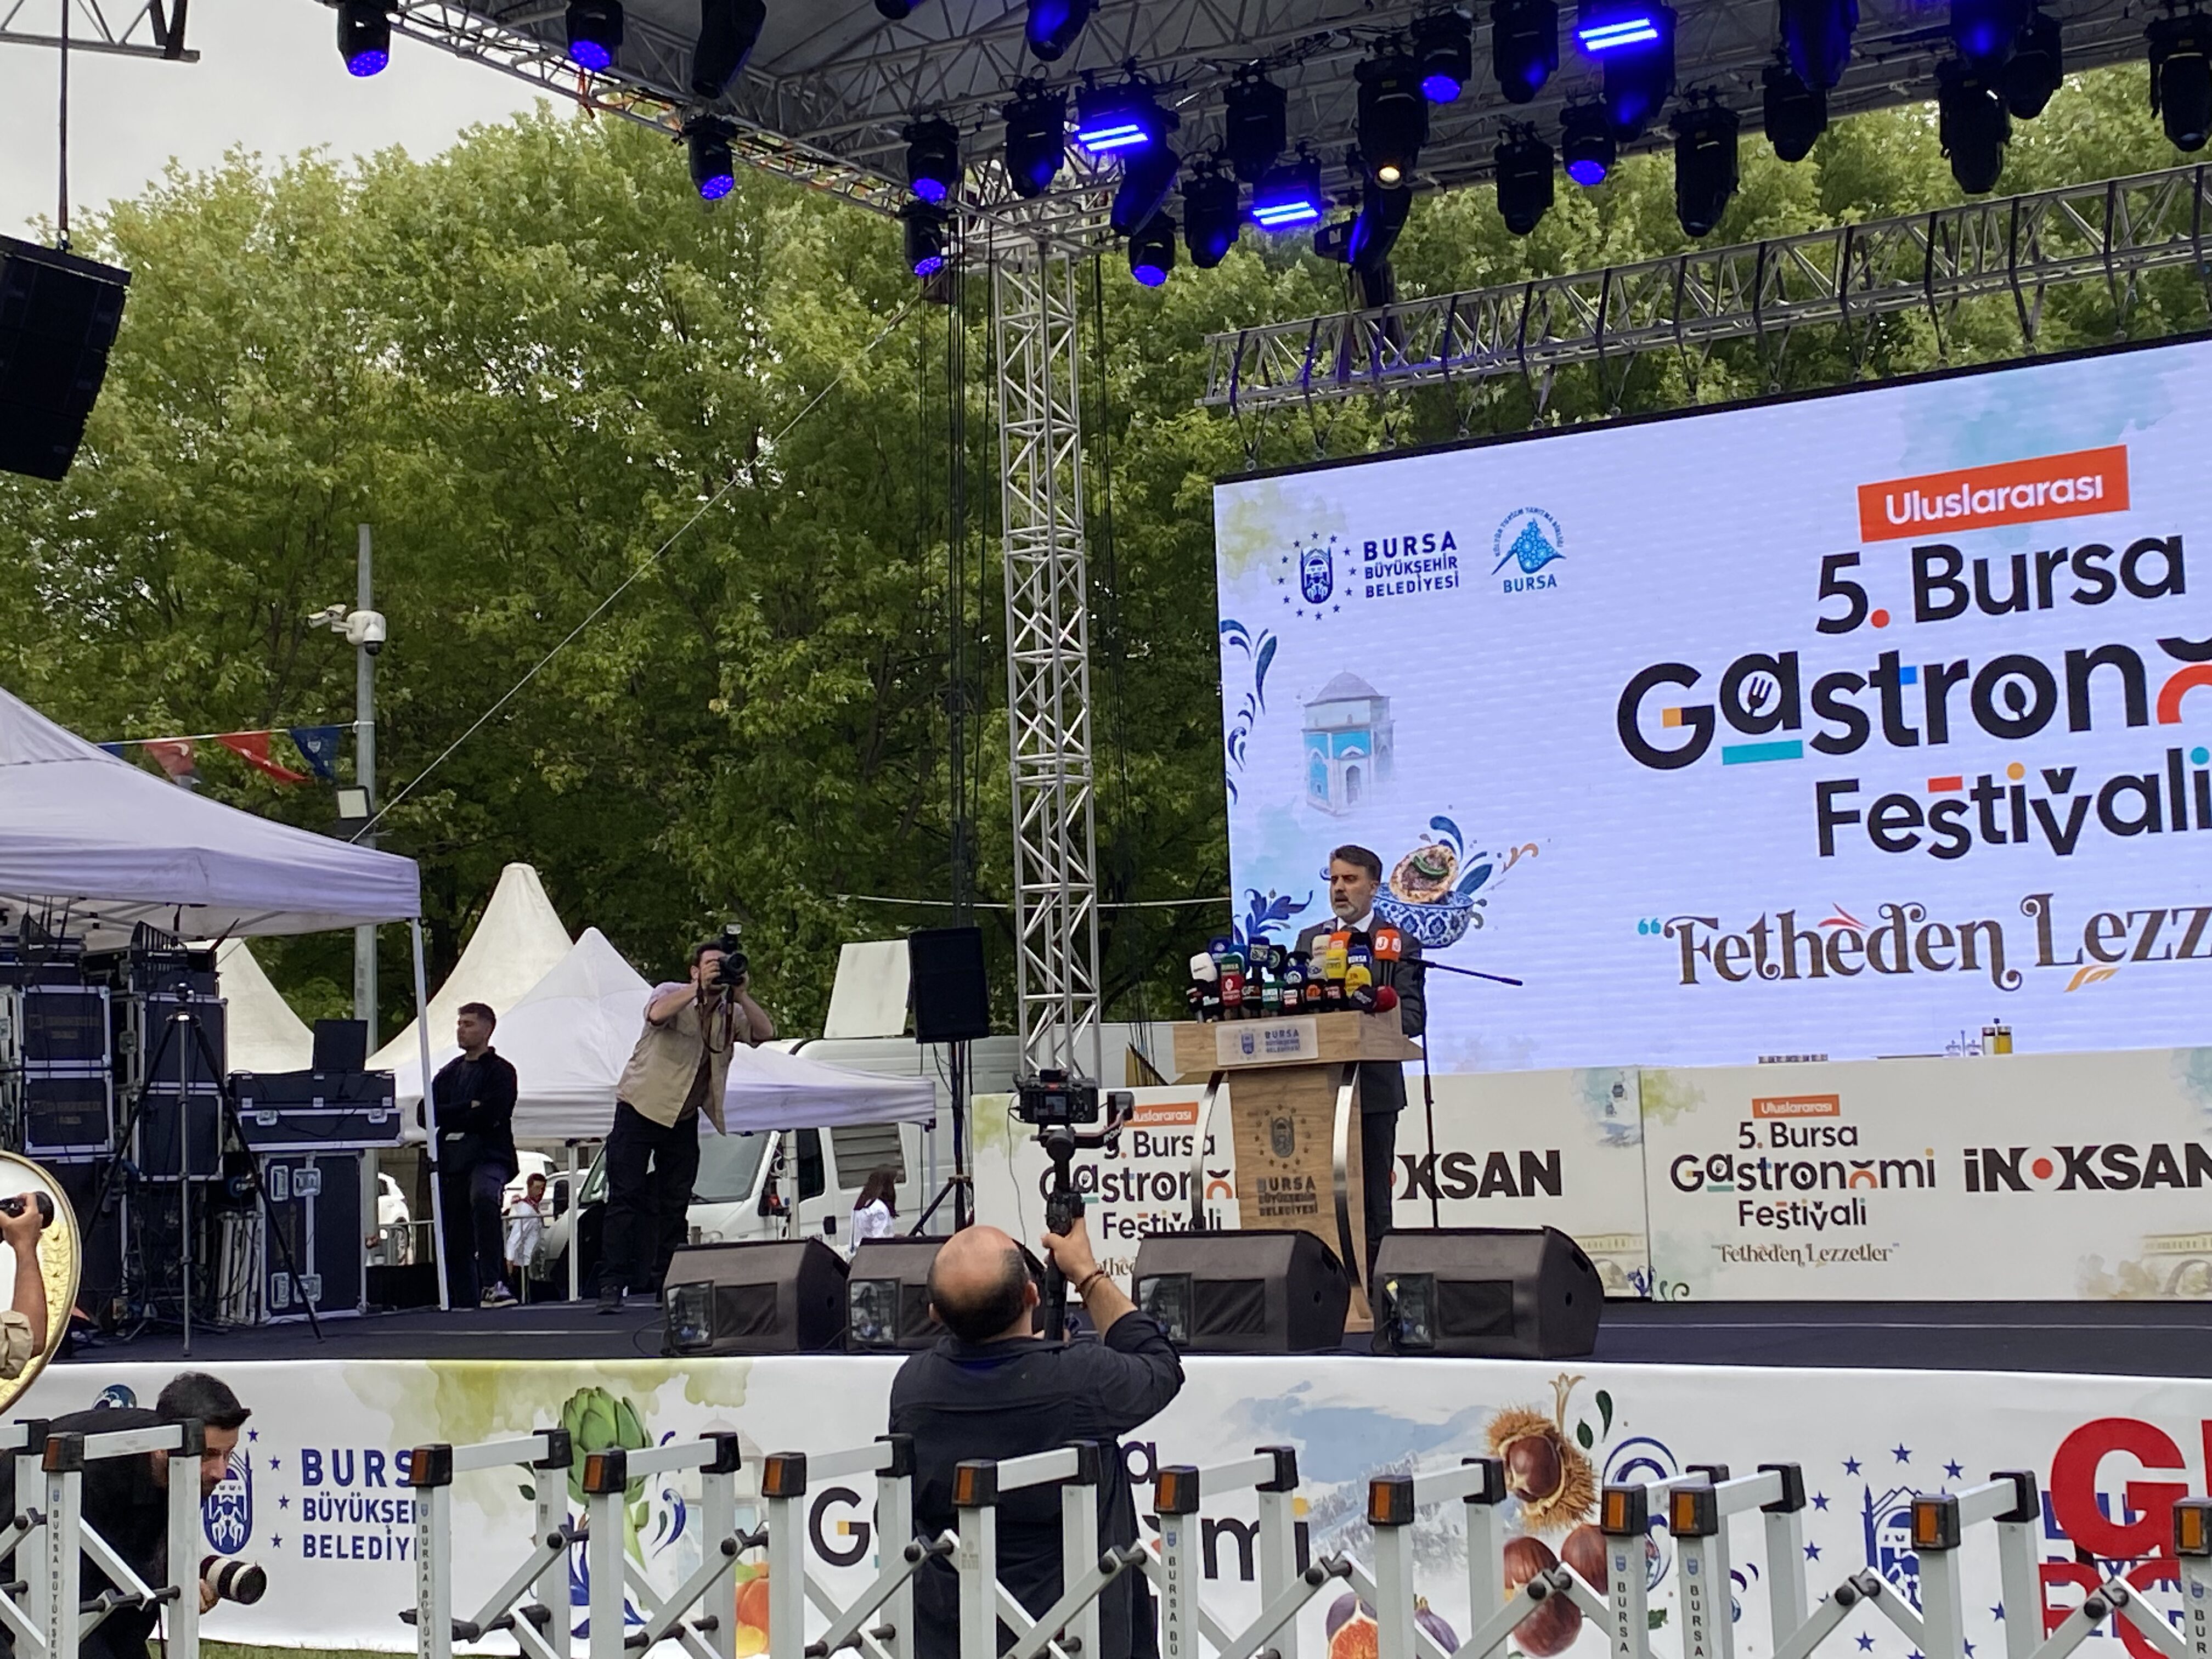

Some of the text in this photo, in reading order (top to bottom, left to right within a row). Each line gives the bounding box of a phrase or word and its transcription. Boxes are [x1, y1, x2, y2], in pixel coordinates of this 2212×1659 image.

[1886, 472, 2104, 525] Uluslararası
[1364, 531, 1457, 562] BURSA
[1365, 571, 1459, 599] BELEDİYESİ
[1503, 574, 1558, 594] BURSA
[1815, 534, 2186, 635] 5. Bursa
[1815, 746, 2212, 859] Festivali
[1761, 1102, 1833, 1115] Uluslararası
[1739, 1121, 1859, 1150] 5. Bursa
[1738, 1197, 1867, 1231] Festivali
[301, 1448, 413, 1488] BURS
[303, 1491, 416, 1528] BÜYÜKŞE
[303, 1528, 416, 1561] BELEDİY
[1169, 1556, 1178, 1622] BURSA
[1617, 1582, 1630, 1653] BURSA
[1690, 1585, 1704, 1657] BURSA
[2194, 1609, 2208, 1659] BUR
